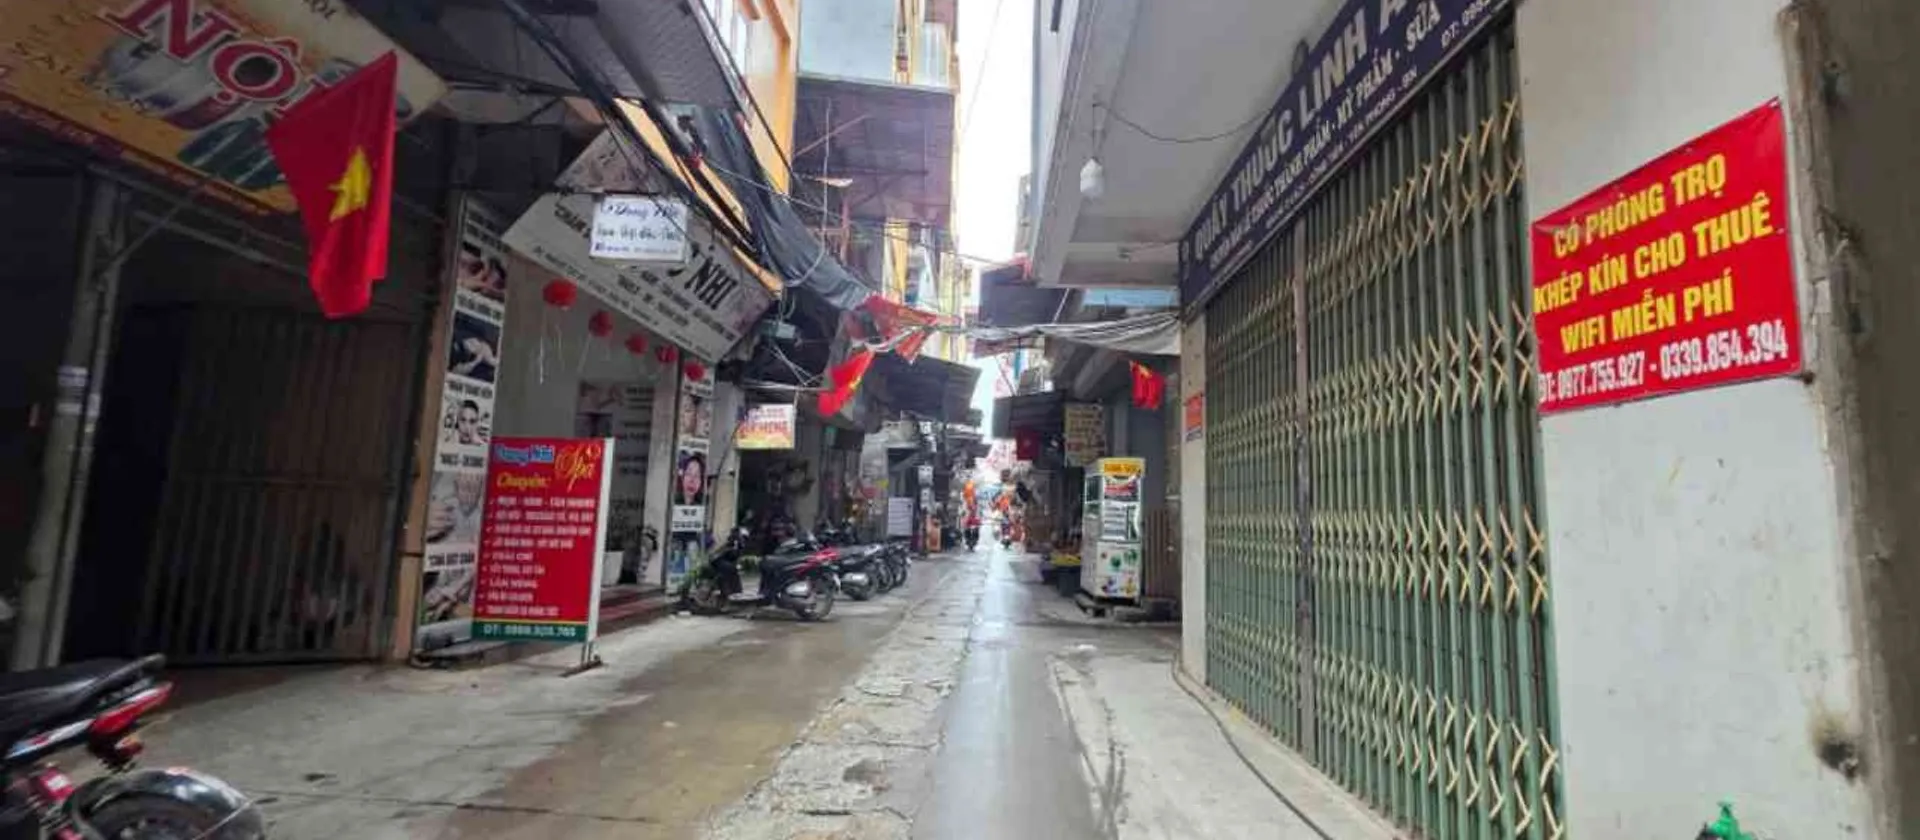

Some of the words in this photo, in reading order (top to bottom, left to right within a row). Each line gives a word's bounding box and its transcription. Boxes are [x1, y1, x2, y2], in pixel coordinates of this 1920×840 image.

[1194, 192, 1228, 261] QUẦY
[1231, 108, 1294, 212] THUỐC
[1298, 7, 1368, 131] LINH
[1302, 117, 1332, 166] PHẨM
[1356, 47, 1393, 108] PHẨM
[1533, 270, 1585, 315] KHÉP
[1588, 252, 1629, 296] KÍN
[1633, 231, 1687, 280] CHO
[1691, 189, 1774, 258] THUÊ
[1553, 215, 1585, 258] CÓ
[1584, 183, 1667, 246] PHÒNG
[1671, 152, 1727, 206] TRỌ
[684, 255, 738, 311] NHI
[1560, 315, 1606, 355] WIFI
[1611, 286, 1676, 341] MIỄN
[1683, 267, 1735, 323] PHÍ
[1557, 350, 1645, 401] 0977.755.927
[1659, 318, 1789, 381] 0339.854.394
[555, 442, 598, 493] Spa
